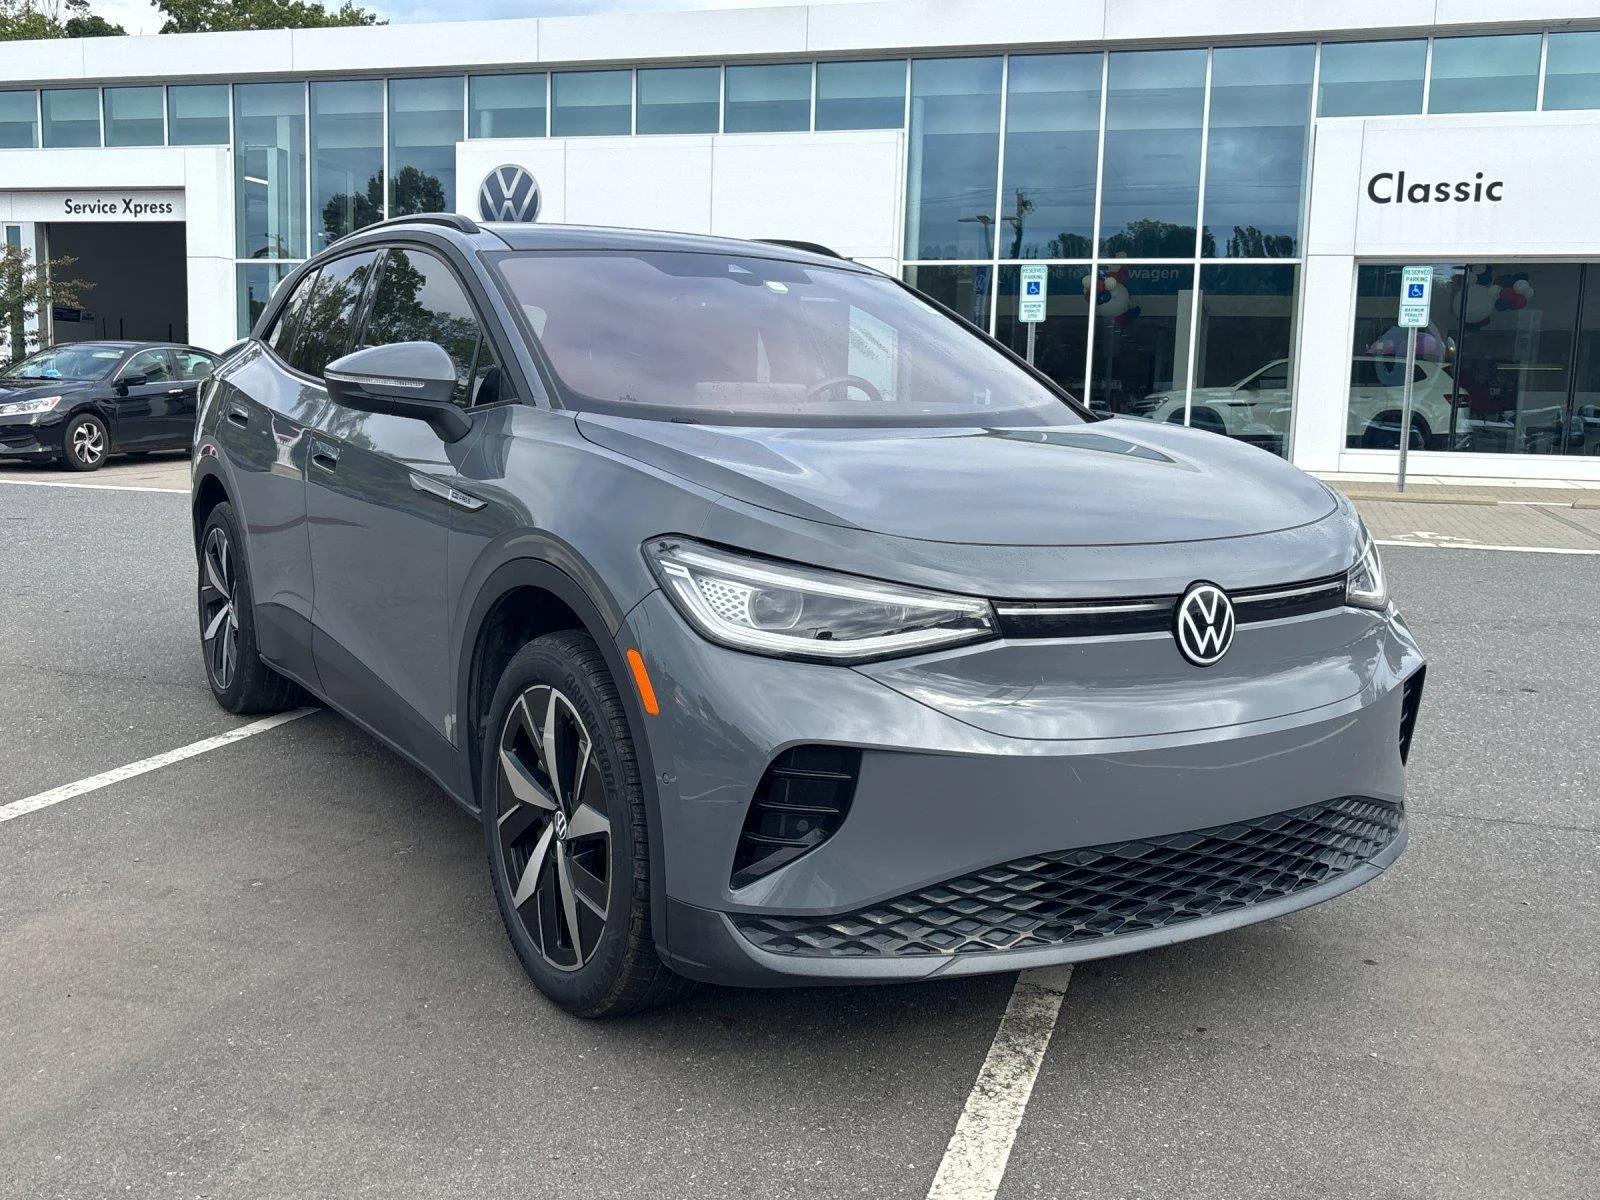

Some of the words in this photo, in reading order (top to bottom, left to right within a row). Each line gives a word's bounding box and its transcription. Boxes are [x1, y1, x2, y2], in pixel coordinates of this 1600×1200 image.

[1366, 170, 1504, 204] Classic
[64, 198, 118, 215] Service
[122, 198, 174, 218] Xpress
